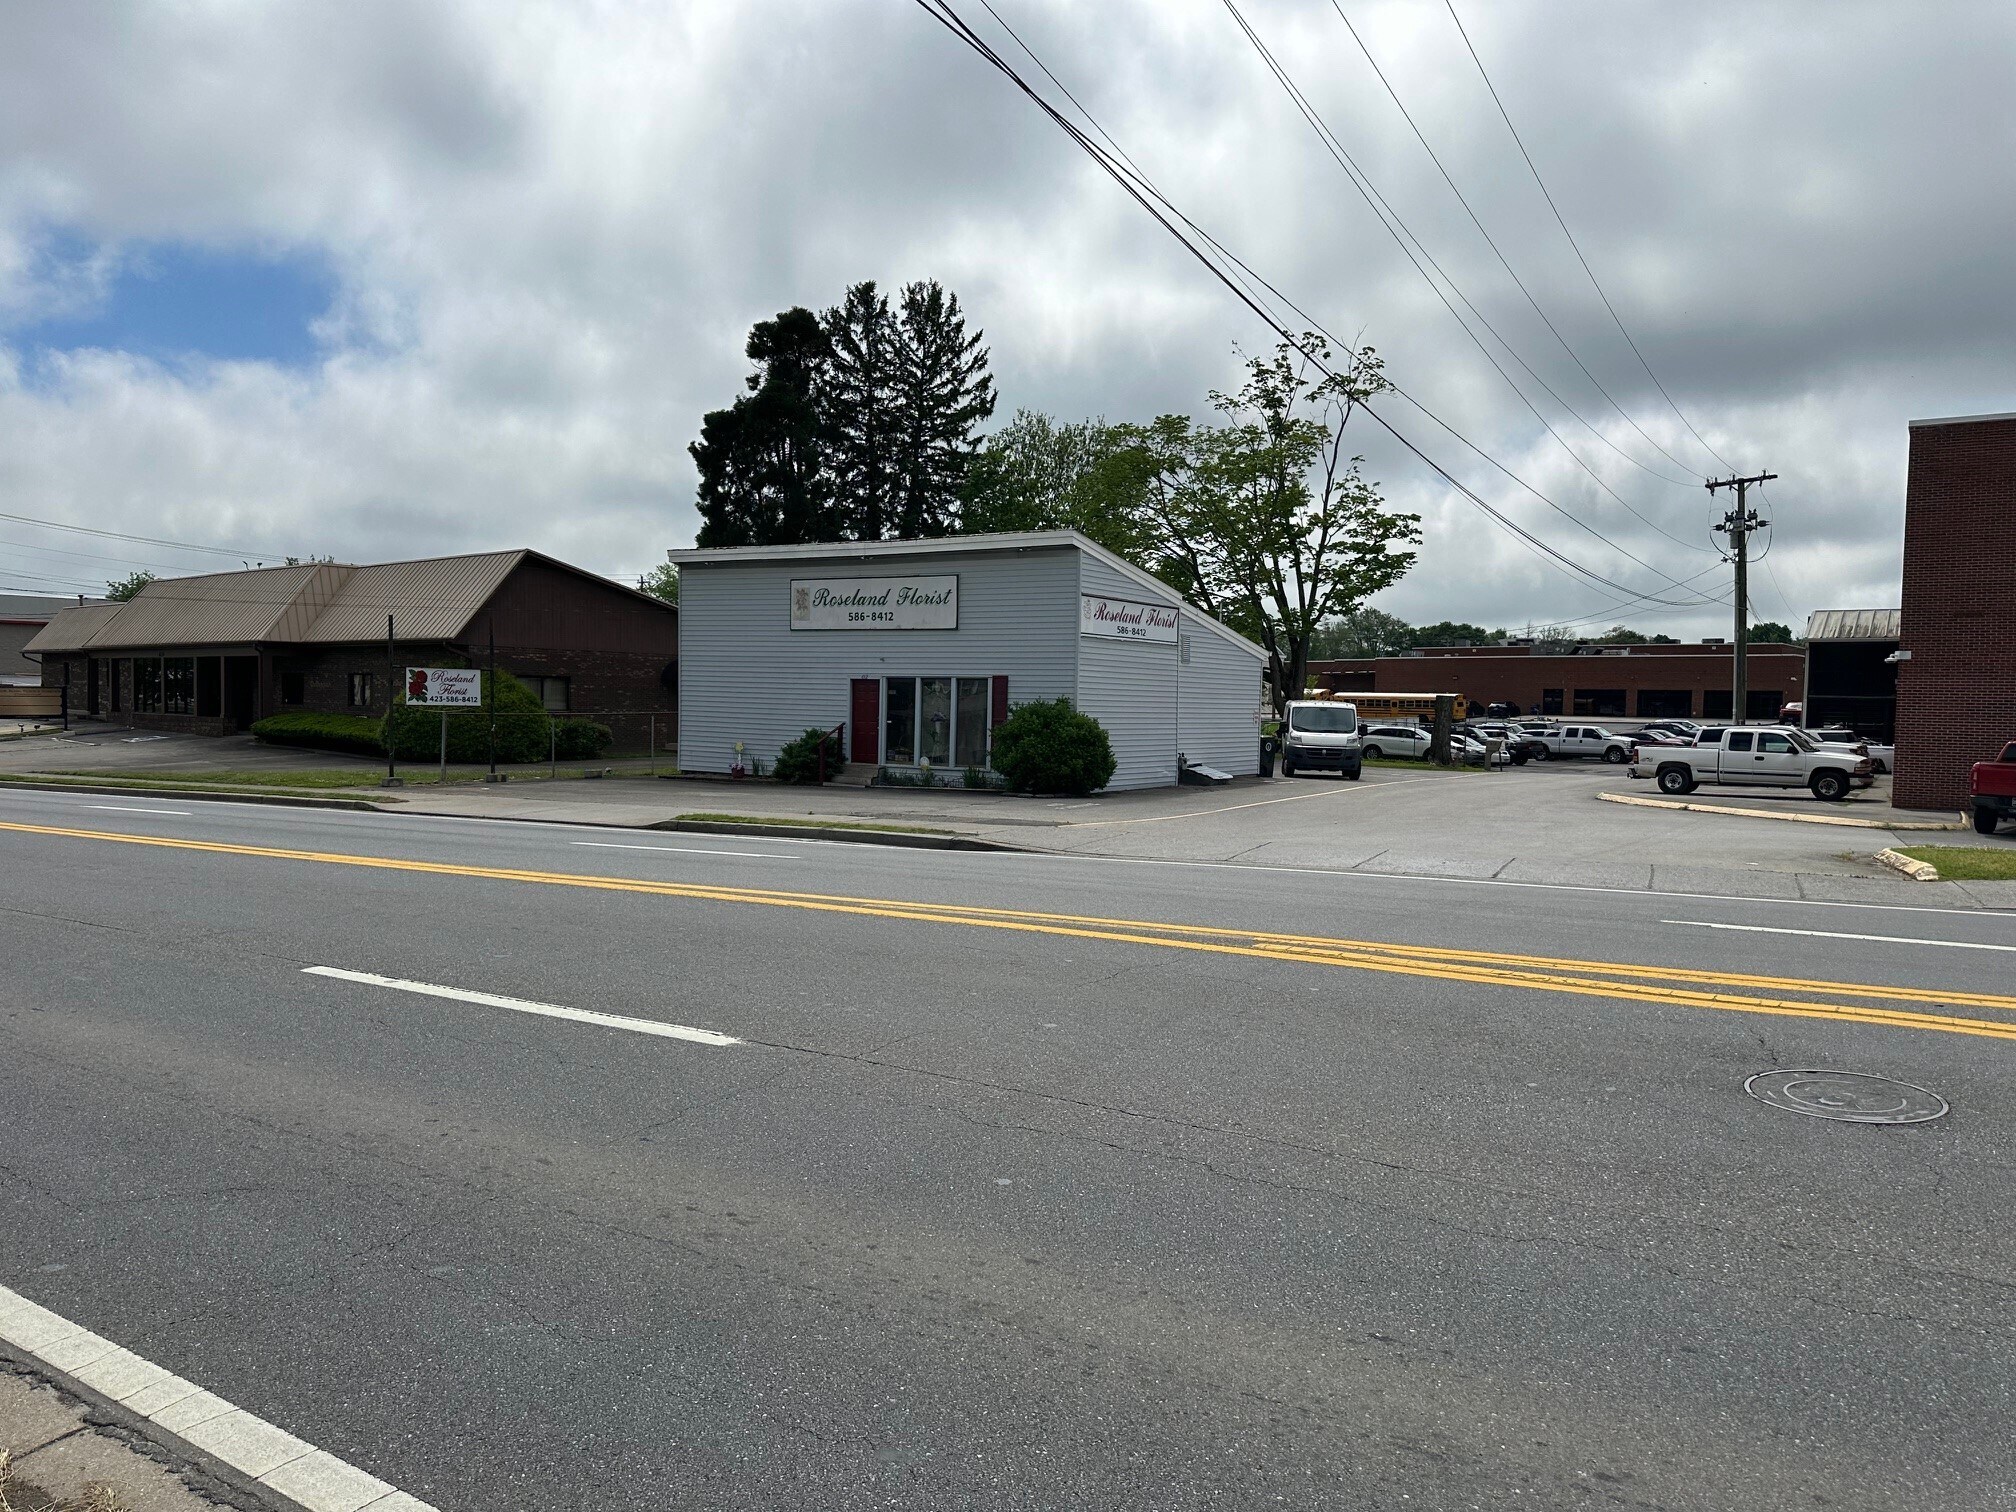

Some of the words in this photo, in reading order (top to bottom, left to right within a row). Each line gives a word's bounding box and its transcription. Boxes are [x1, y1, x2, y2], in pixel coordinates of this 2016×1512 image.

[812, 588, 890, 607] Roseland
[896, 586, 952, 606] Florist
[848, 612, 894, 622] 586-8412
[1094, 602, 1145, 625] Roseland
[1146, 608, 1178, 628] Florist
[1117, 626, 1146, 636] 586-8412
[431, 670, 476, 683] Roseland
[438, 683, 468, 695] Florist
